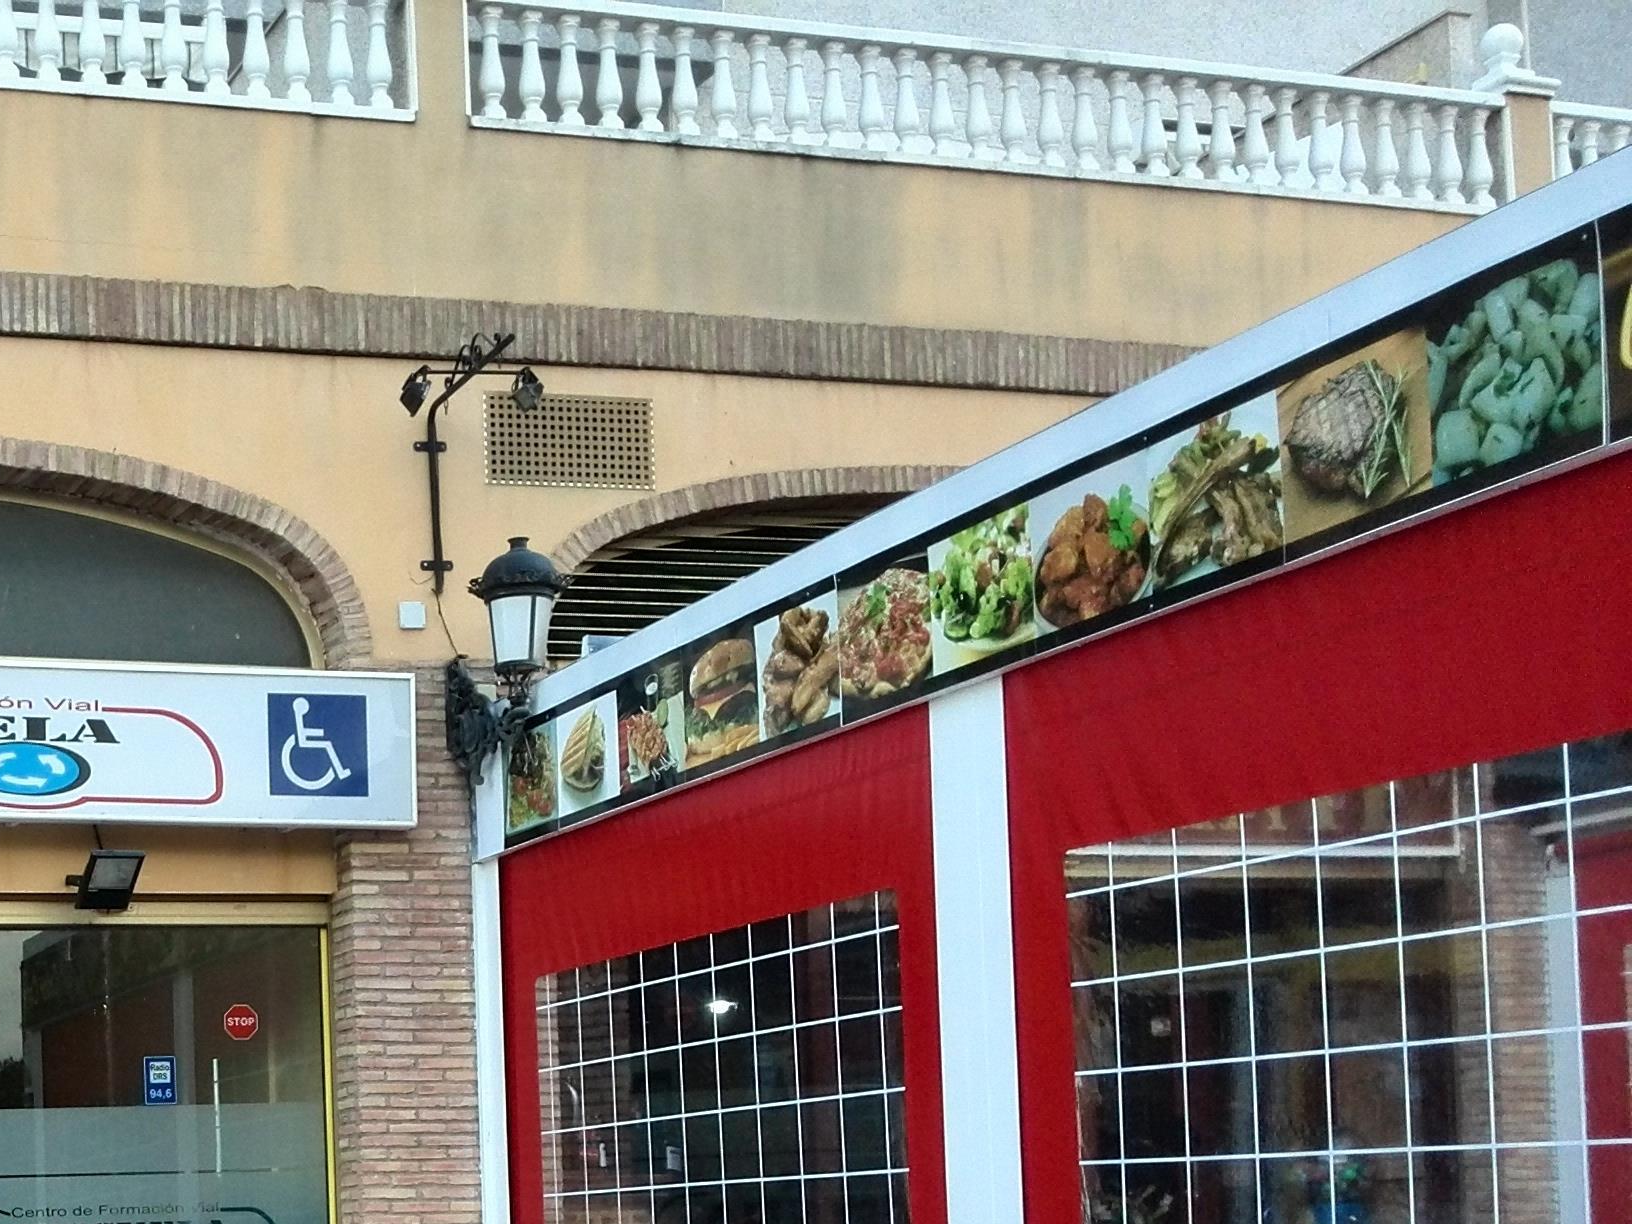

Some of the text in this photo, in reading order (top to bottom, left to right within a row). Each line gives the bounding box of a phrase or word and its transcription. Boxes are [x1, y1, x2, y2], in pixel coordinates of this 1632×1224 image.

[45, 698, 99, 712] Vial
[227, 1017, 255, 1026] STOP
[11, 1206, 67, 1218] Centro
[73, 1205, 92, 1216] de
[99, 1203, 184, 1216] Formación
